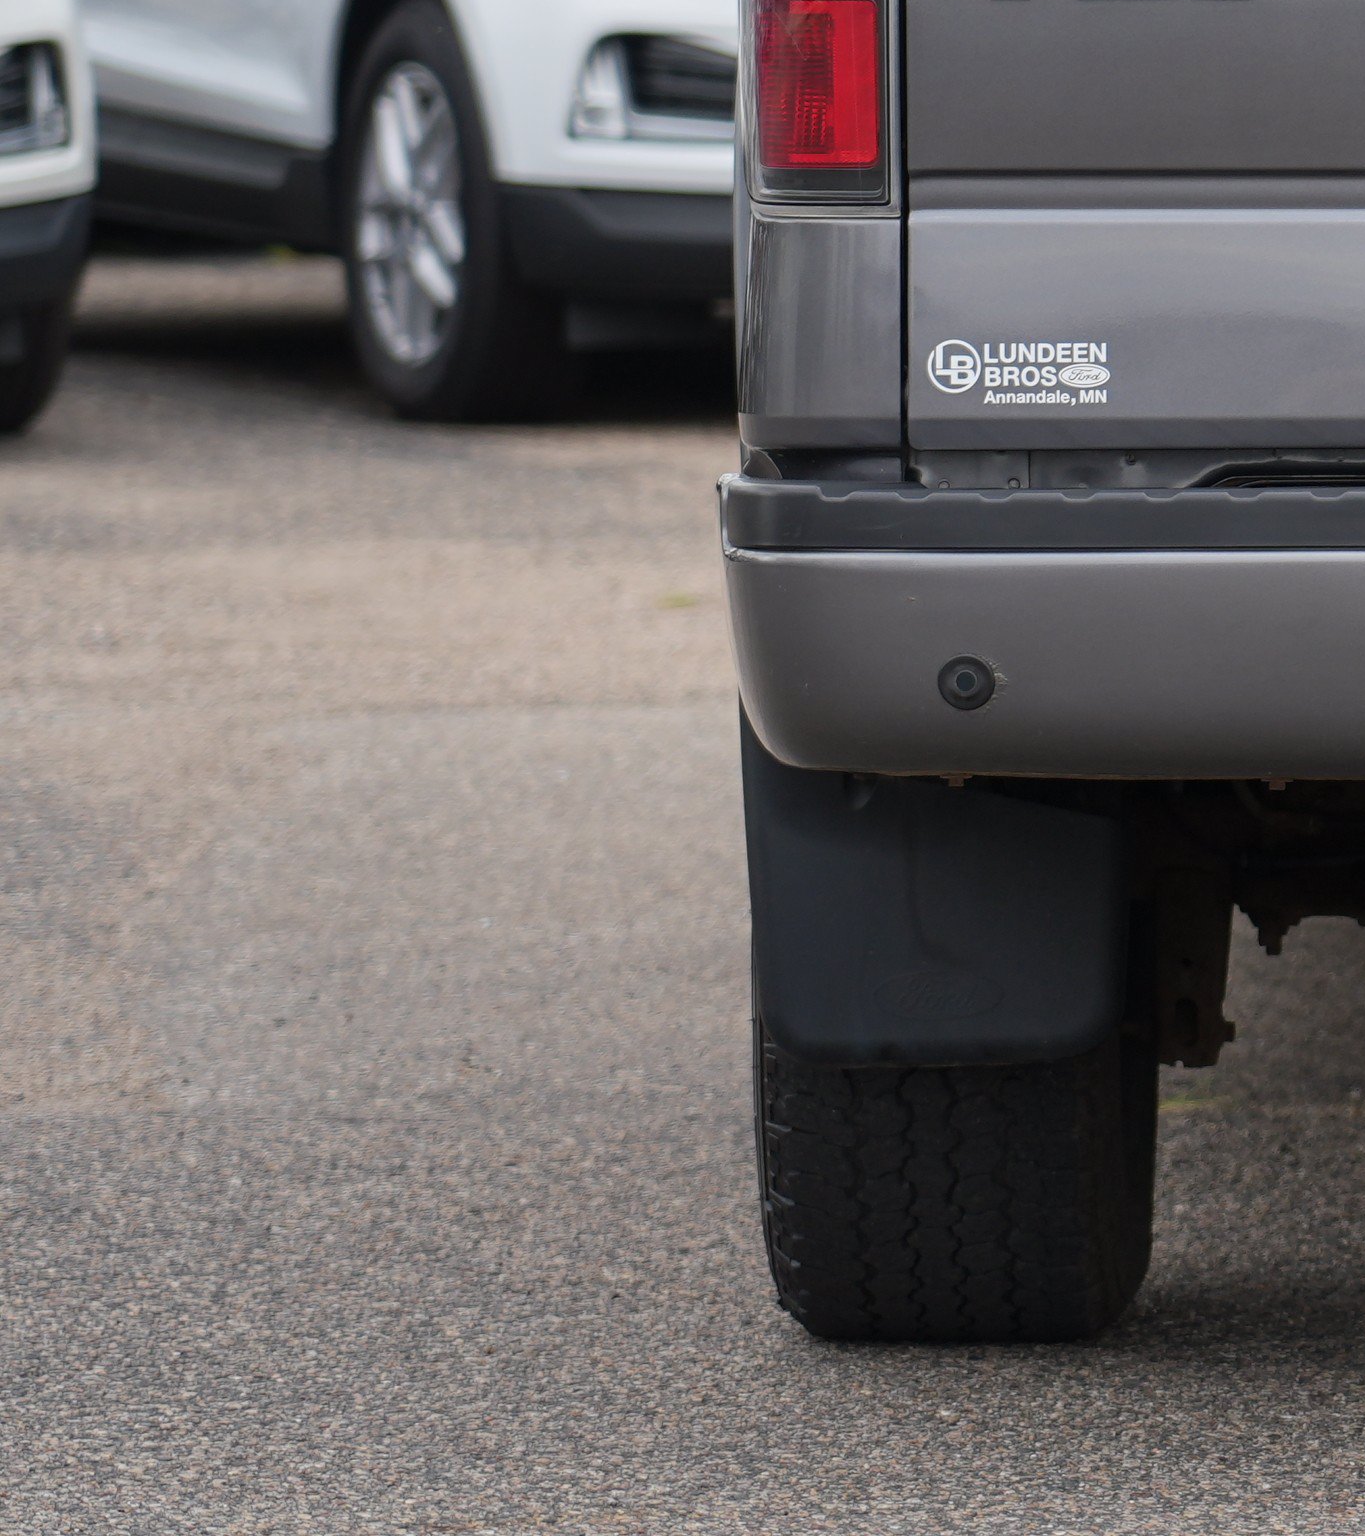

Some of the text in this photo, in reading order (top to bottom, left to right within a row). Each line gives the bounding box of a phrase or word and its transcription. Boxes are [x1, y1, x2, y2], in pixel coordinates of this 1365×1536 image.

[984, 343, 1107, 364] LUNDEEN
[985, 366, 1057, 387] BROS
[984, 390, 1107, 406] Annandale, MN
